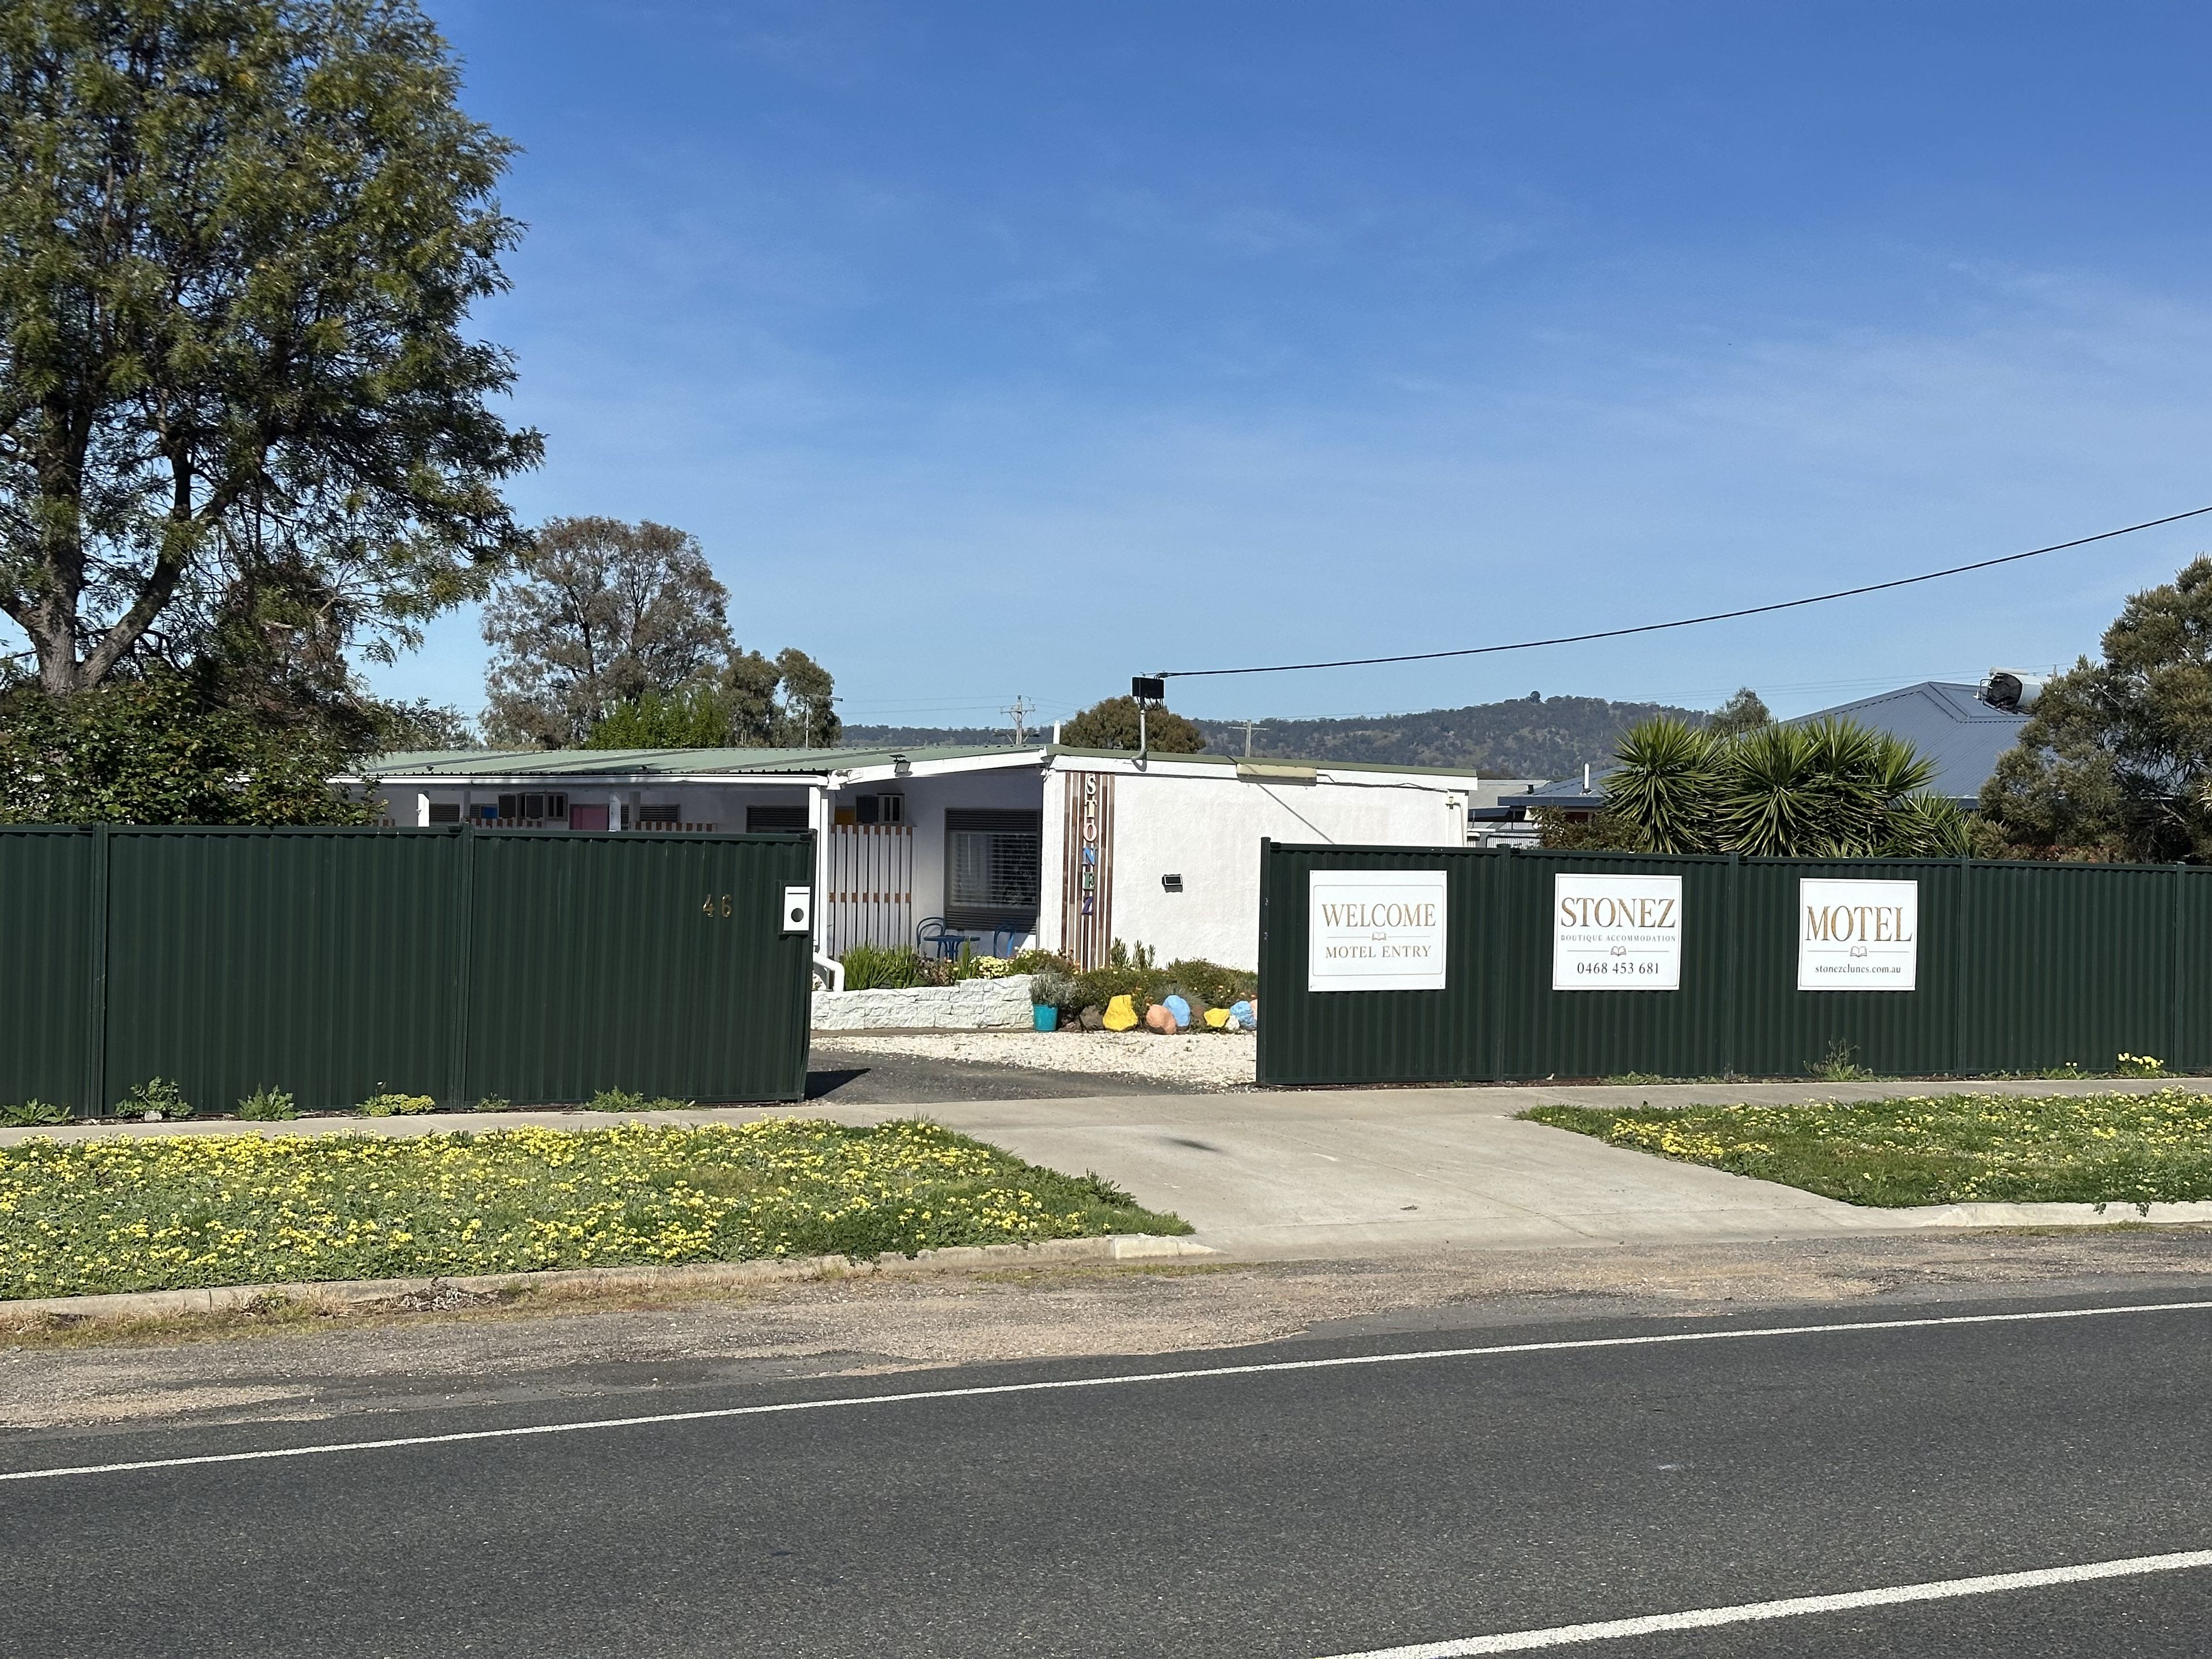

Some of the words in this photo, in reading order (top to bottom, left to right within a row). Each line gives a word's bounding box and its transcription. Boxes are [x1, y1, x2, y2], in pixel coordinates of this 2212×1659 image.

[1082, 774, 1097, 915] STONEZ
[703, 894, 732, 918] 46
[1321, 903, 1436, 927] WELCOME
[1560, 897, 1676, 928] STONEZ
[1804, 905, 1913, 942] MOTEL
[1560, 934, 1603, 943] BOUTIQUE
[1325, 946, 1377, 959] MOTEL
[1382, 945, 1431, 958] ENTRY
[1577, 962, 1608, 974] 0468
[1612, 962, 1634, 974] 453
[1639, 962, 1659, 974] 681
[1815, 963, 1901, 974] stonezclunes.com.au
